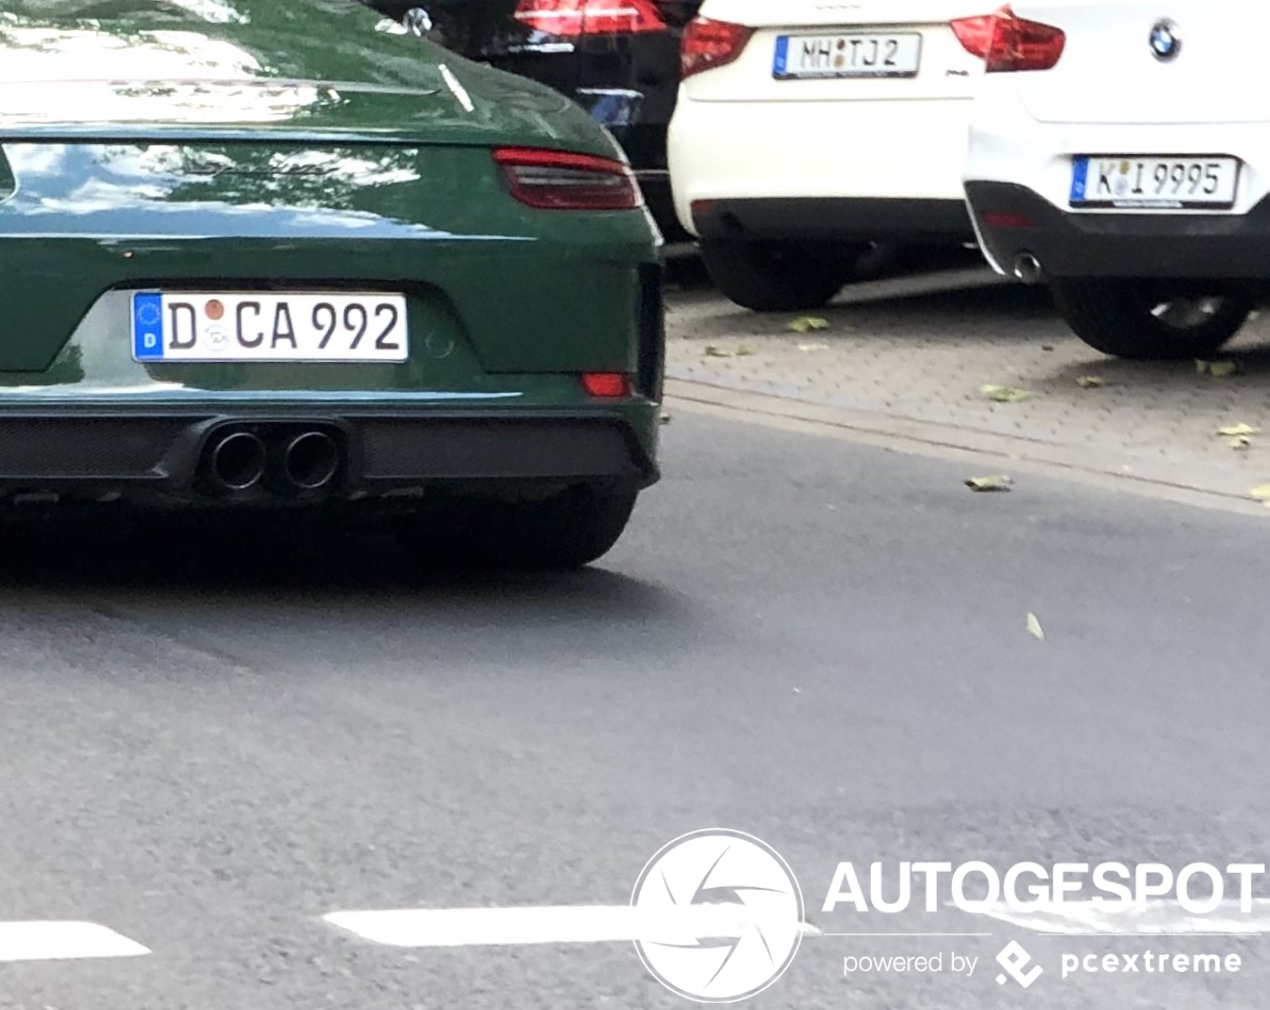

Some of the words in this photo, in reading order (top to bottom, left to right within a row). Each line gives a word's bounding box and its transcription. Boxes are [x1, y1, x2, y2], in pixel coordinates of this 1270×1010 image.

[801, 41, 831, 67] MH
[849, 40, 878, 66] TJ
[883, 40, 899, 66] 2
[1098, 163, 1115, 194] K
[1154, 163, 1221, 194] 9995
[167, 302, 197, 349] D
[236, 301, 297, 349] CA
[311, 302, 400, 350] 992
[143, 333, 157, 348] D
